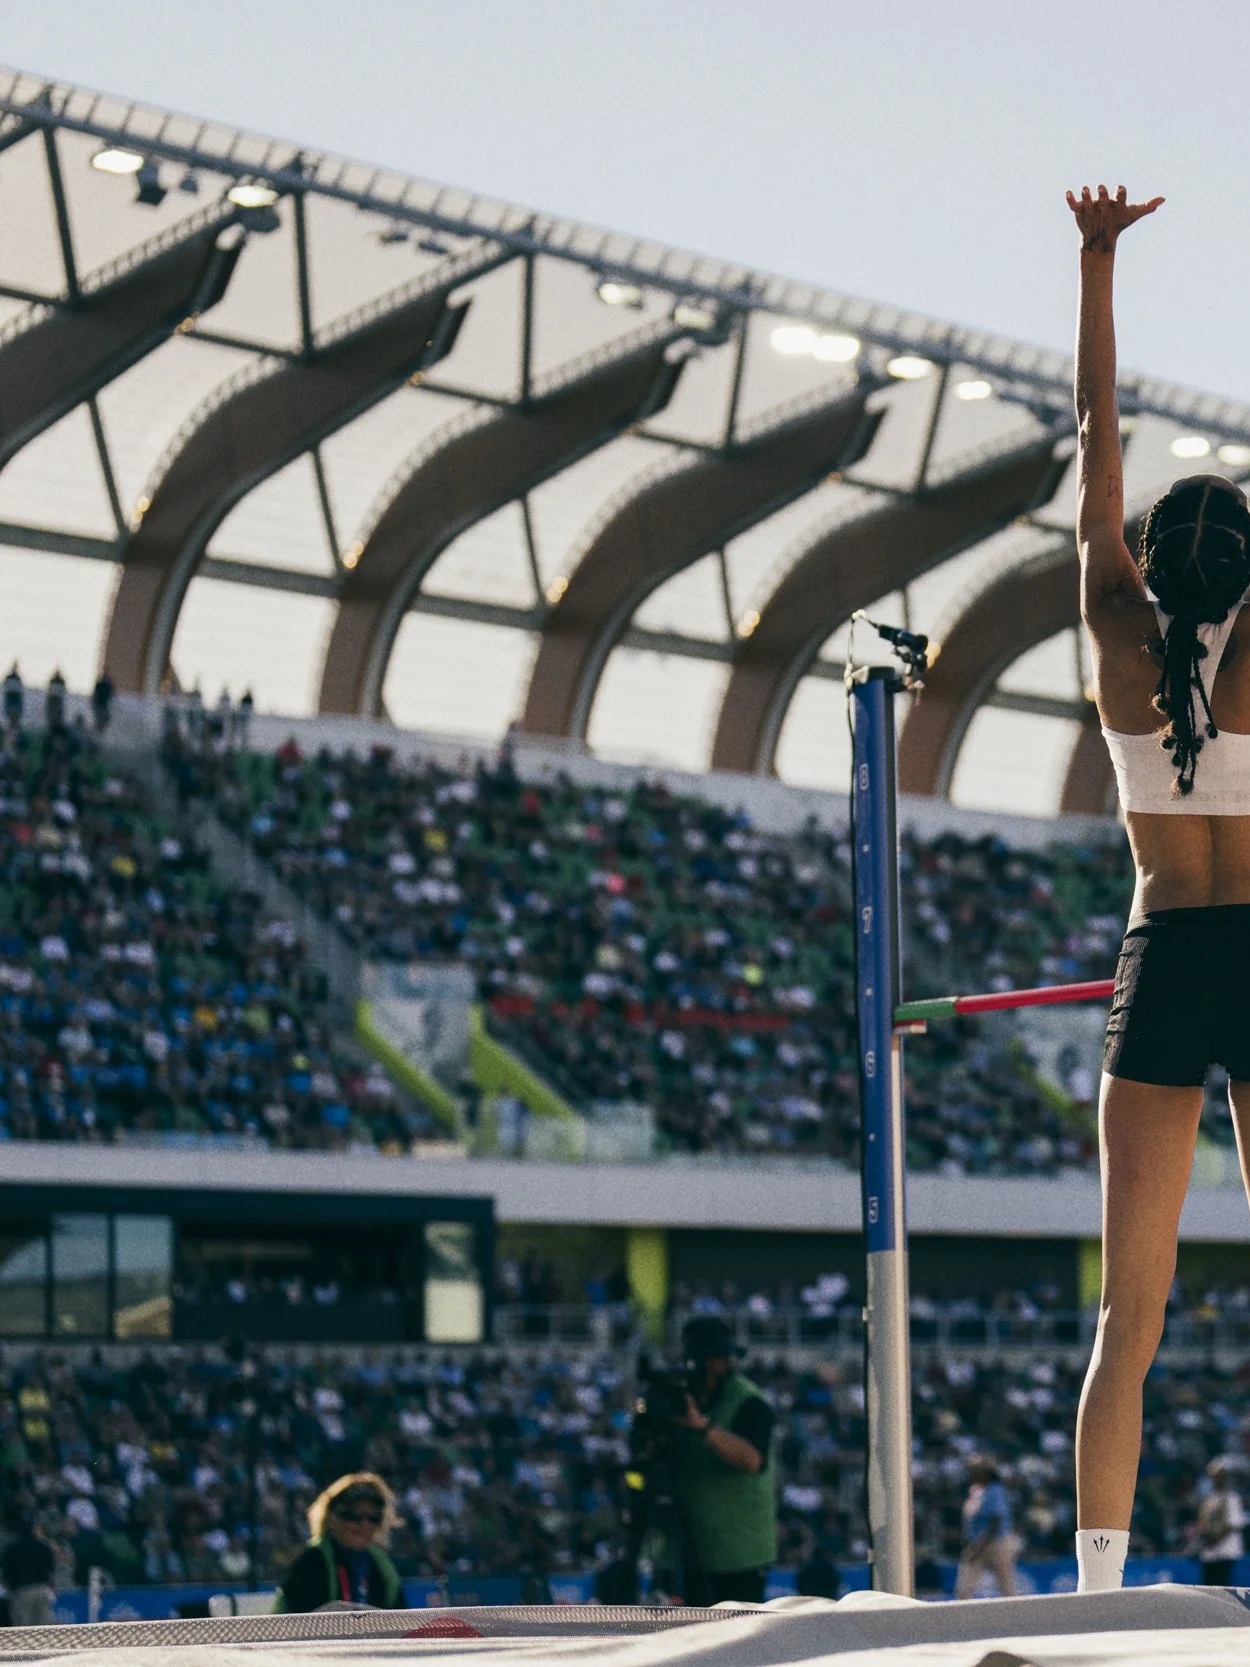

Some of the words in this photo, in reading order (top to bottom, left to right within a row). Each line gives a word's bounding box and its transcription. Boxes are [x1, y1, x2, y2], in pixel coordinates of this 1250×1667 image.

[862, 906, 872, 934] 7
[866, 1051, 875, 1078] 6
[869, 1196, 878, 1224] 5
